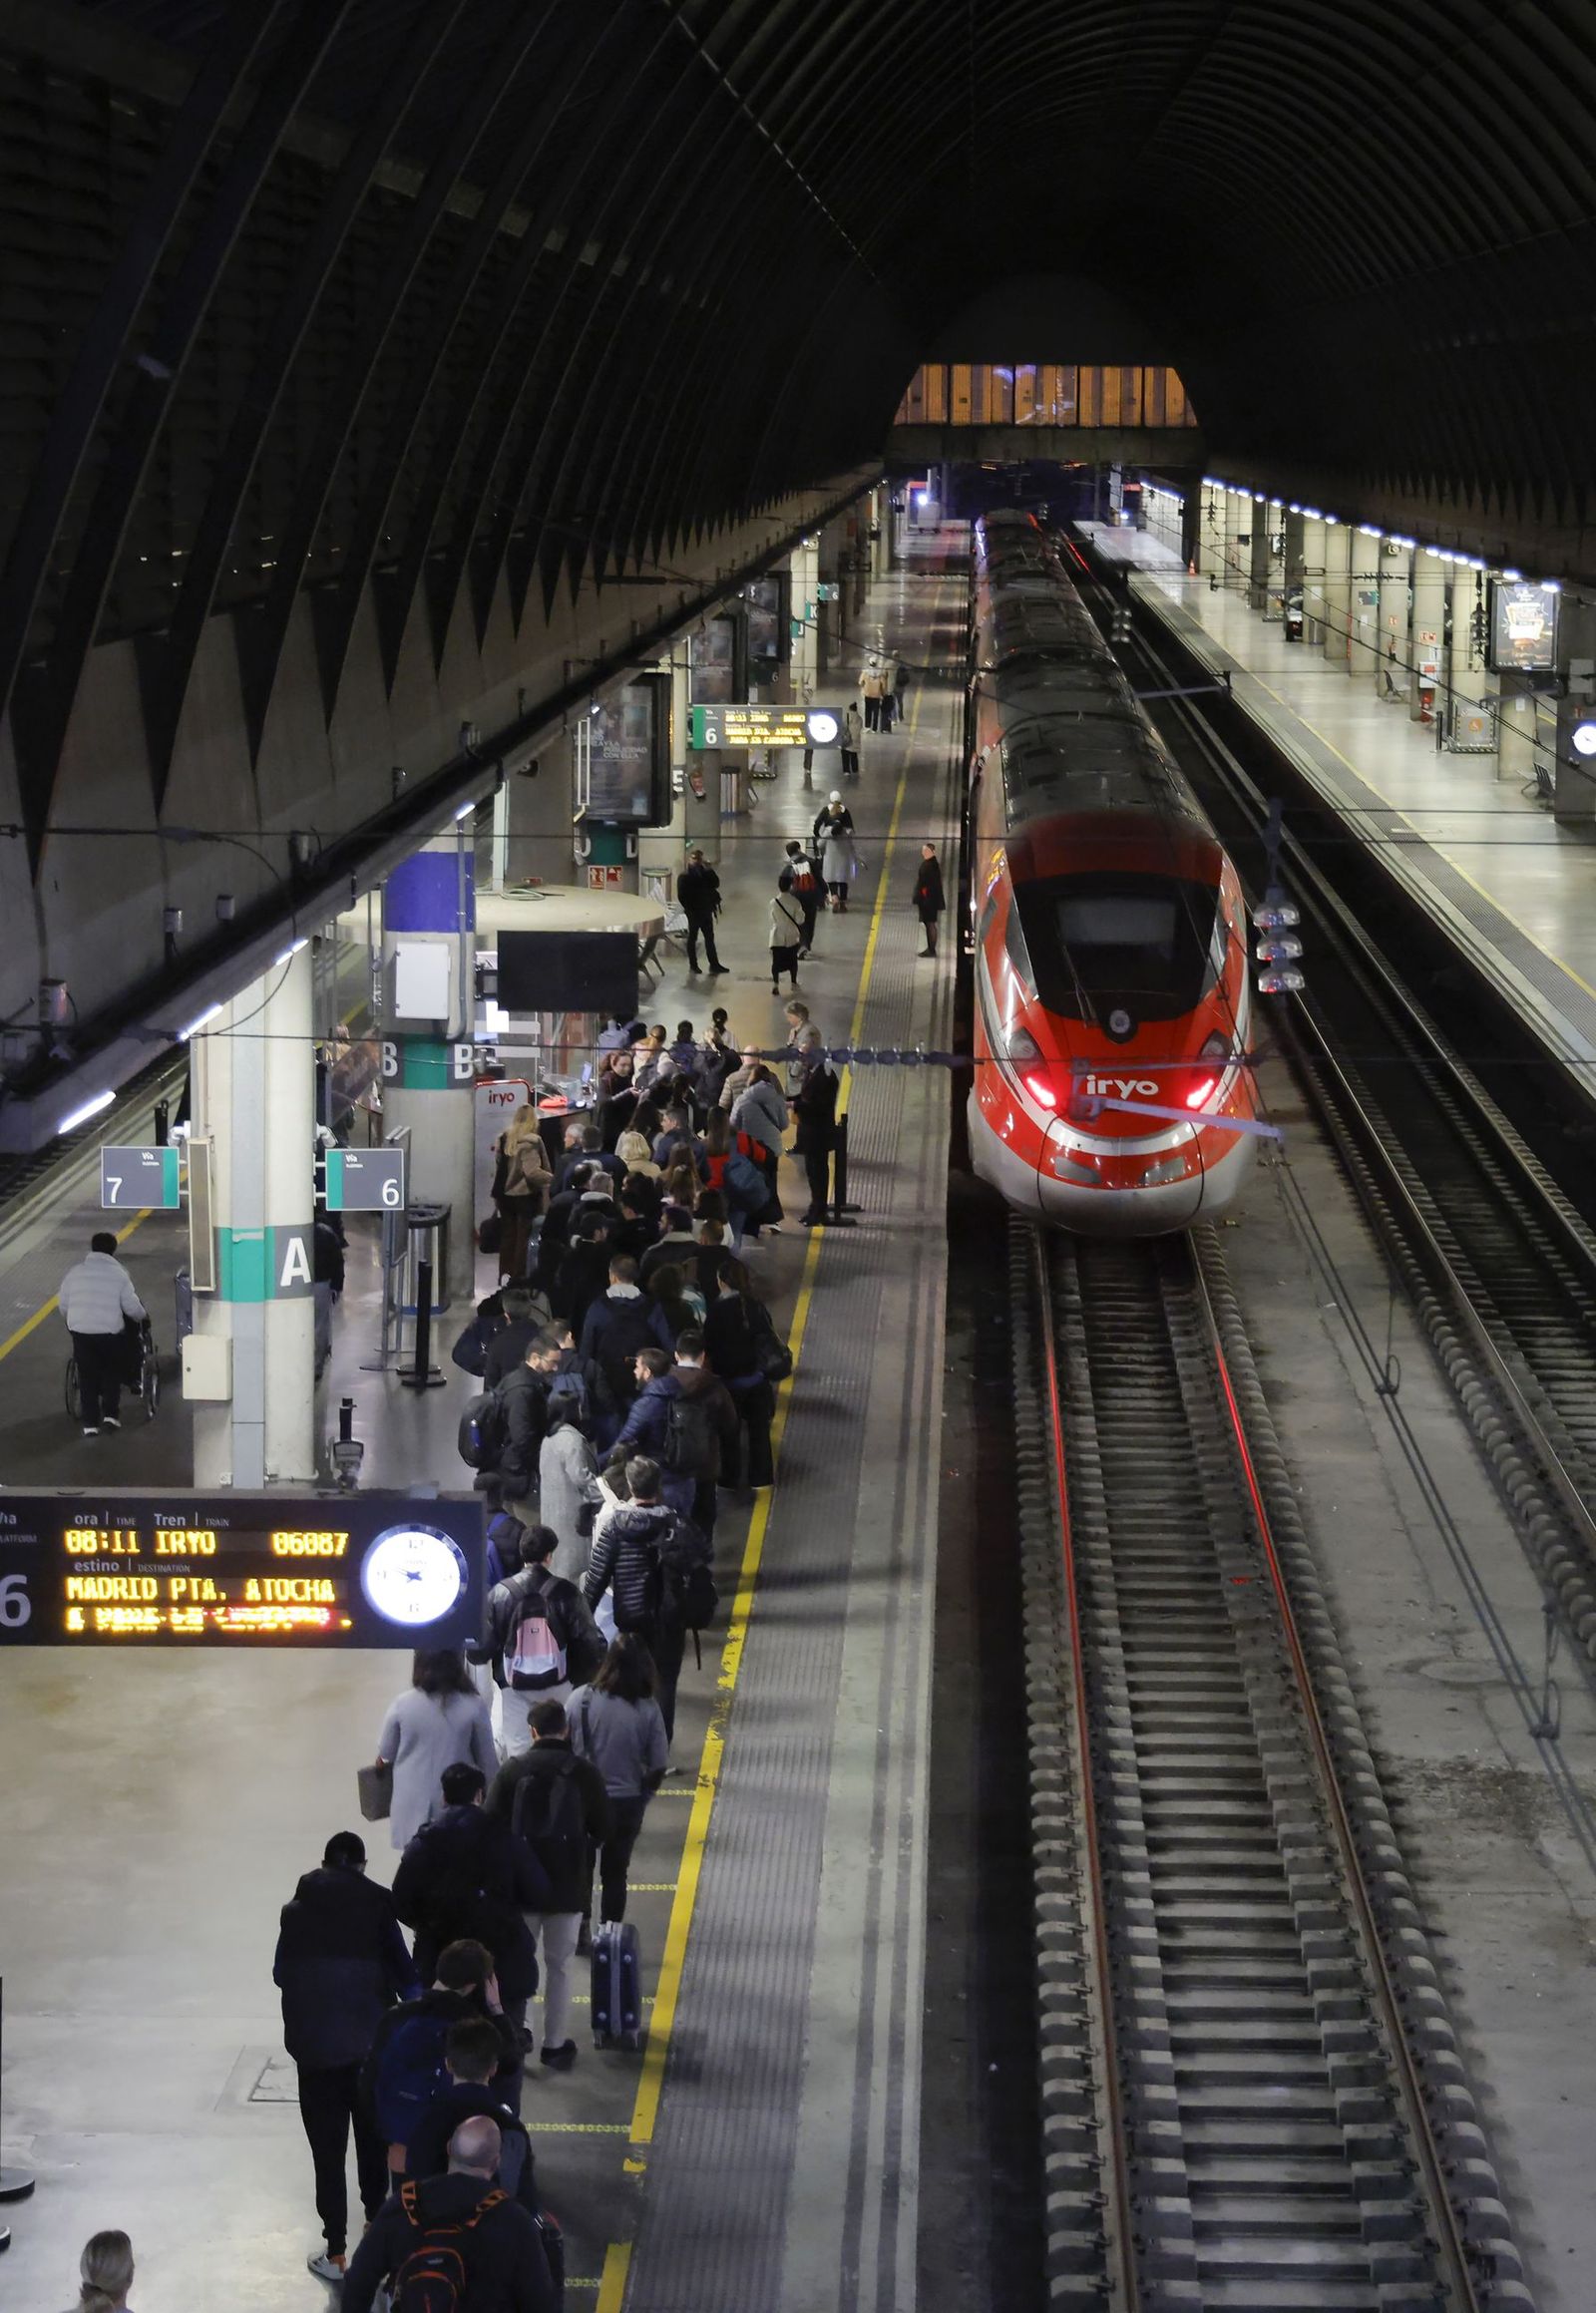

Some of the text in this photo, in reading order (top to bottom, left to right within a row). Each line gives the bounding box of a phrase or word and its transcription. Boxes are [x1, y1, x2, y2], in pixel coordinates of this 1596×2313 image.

[705, 728, 717, 744] 6
[672, 770, 684, 793] E
[382, 1041, 398, 1077] B
[454, 1043, 475, 1080] B
[488, 1090, 516, 1106] iryo
[1086, 1074, 1159, 1101] iryo
[106, 1177, 124, 1204] 7
[381, 1178, 400, 1206] 6
[280, 1237, 312, 1287] A
[117, 1516, 137, 1526] TIME
[154, 1512, 230, 1527] Tren TRAIN
[64, 1529, 349, 1556] 08:11 IRYO 06087
[138, 1562, 192, 1574] DESTINATION
[0, 1574, 32, 1628] 6
[65, 1576, 335, 1602] MADRID PTA. ATOCHA
